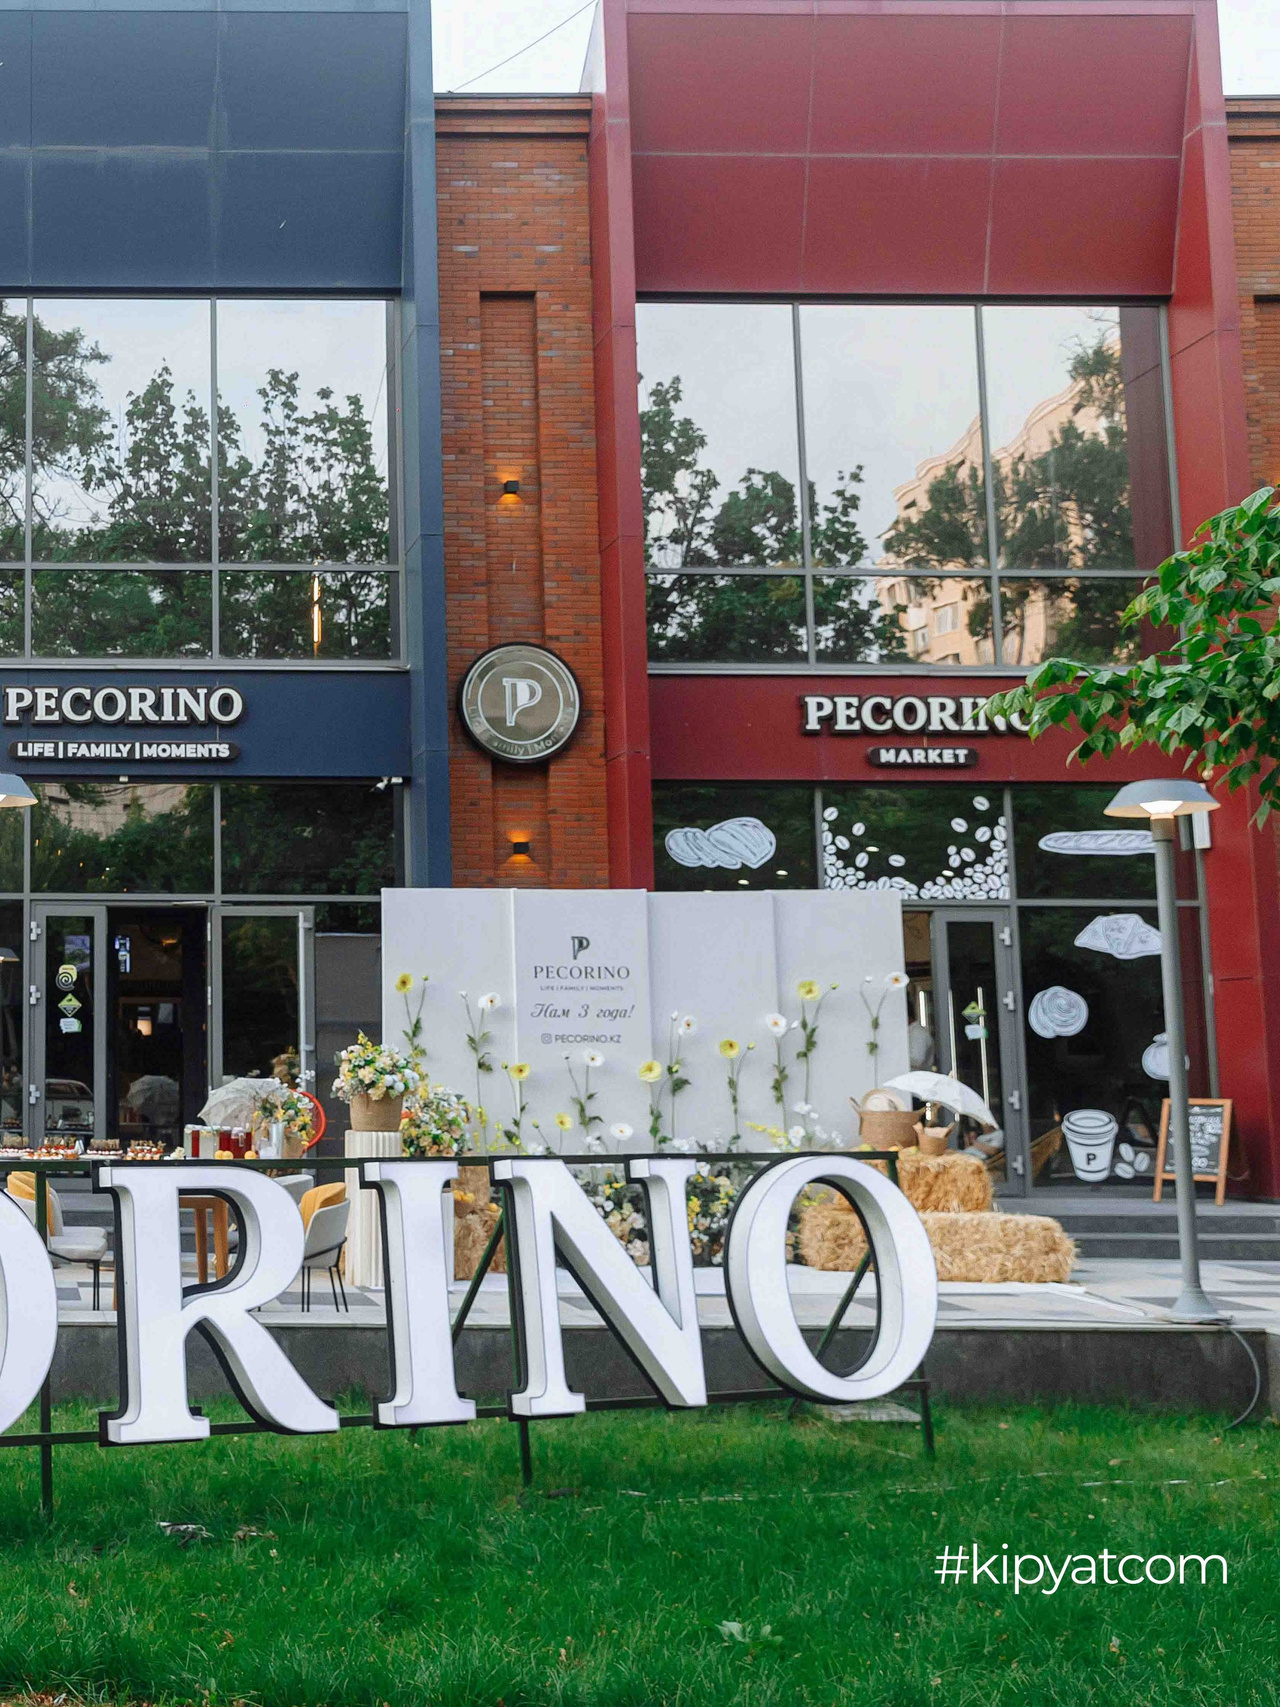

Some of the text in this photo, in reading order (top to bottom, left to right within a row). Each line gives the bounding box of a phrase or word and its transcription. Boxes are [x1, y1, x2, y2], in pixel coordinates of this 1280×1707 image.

[5, 687, 243, 722] PECORINO
[17, 743, 55, 757] LIFE
[67, 743, 132, 758] FAMILY
[143, 743, 230, 758] MOMENTS
[879, 748, 968, 764] MARKET
[533, 965, 630, 979] PECORINO
[530, 1003, 635, 1021] Нам 3 года!
[554, 1034, 622, 1044] PECORINO.KZ
[1086, 1152, 1097, 1165] P
